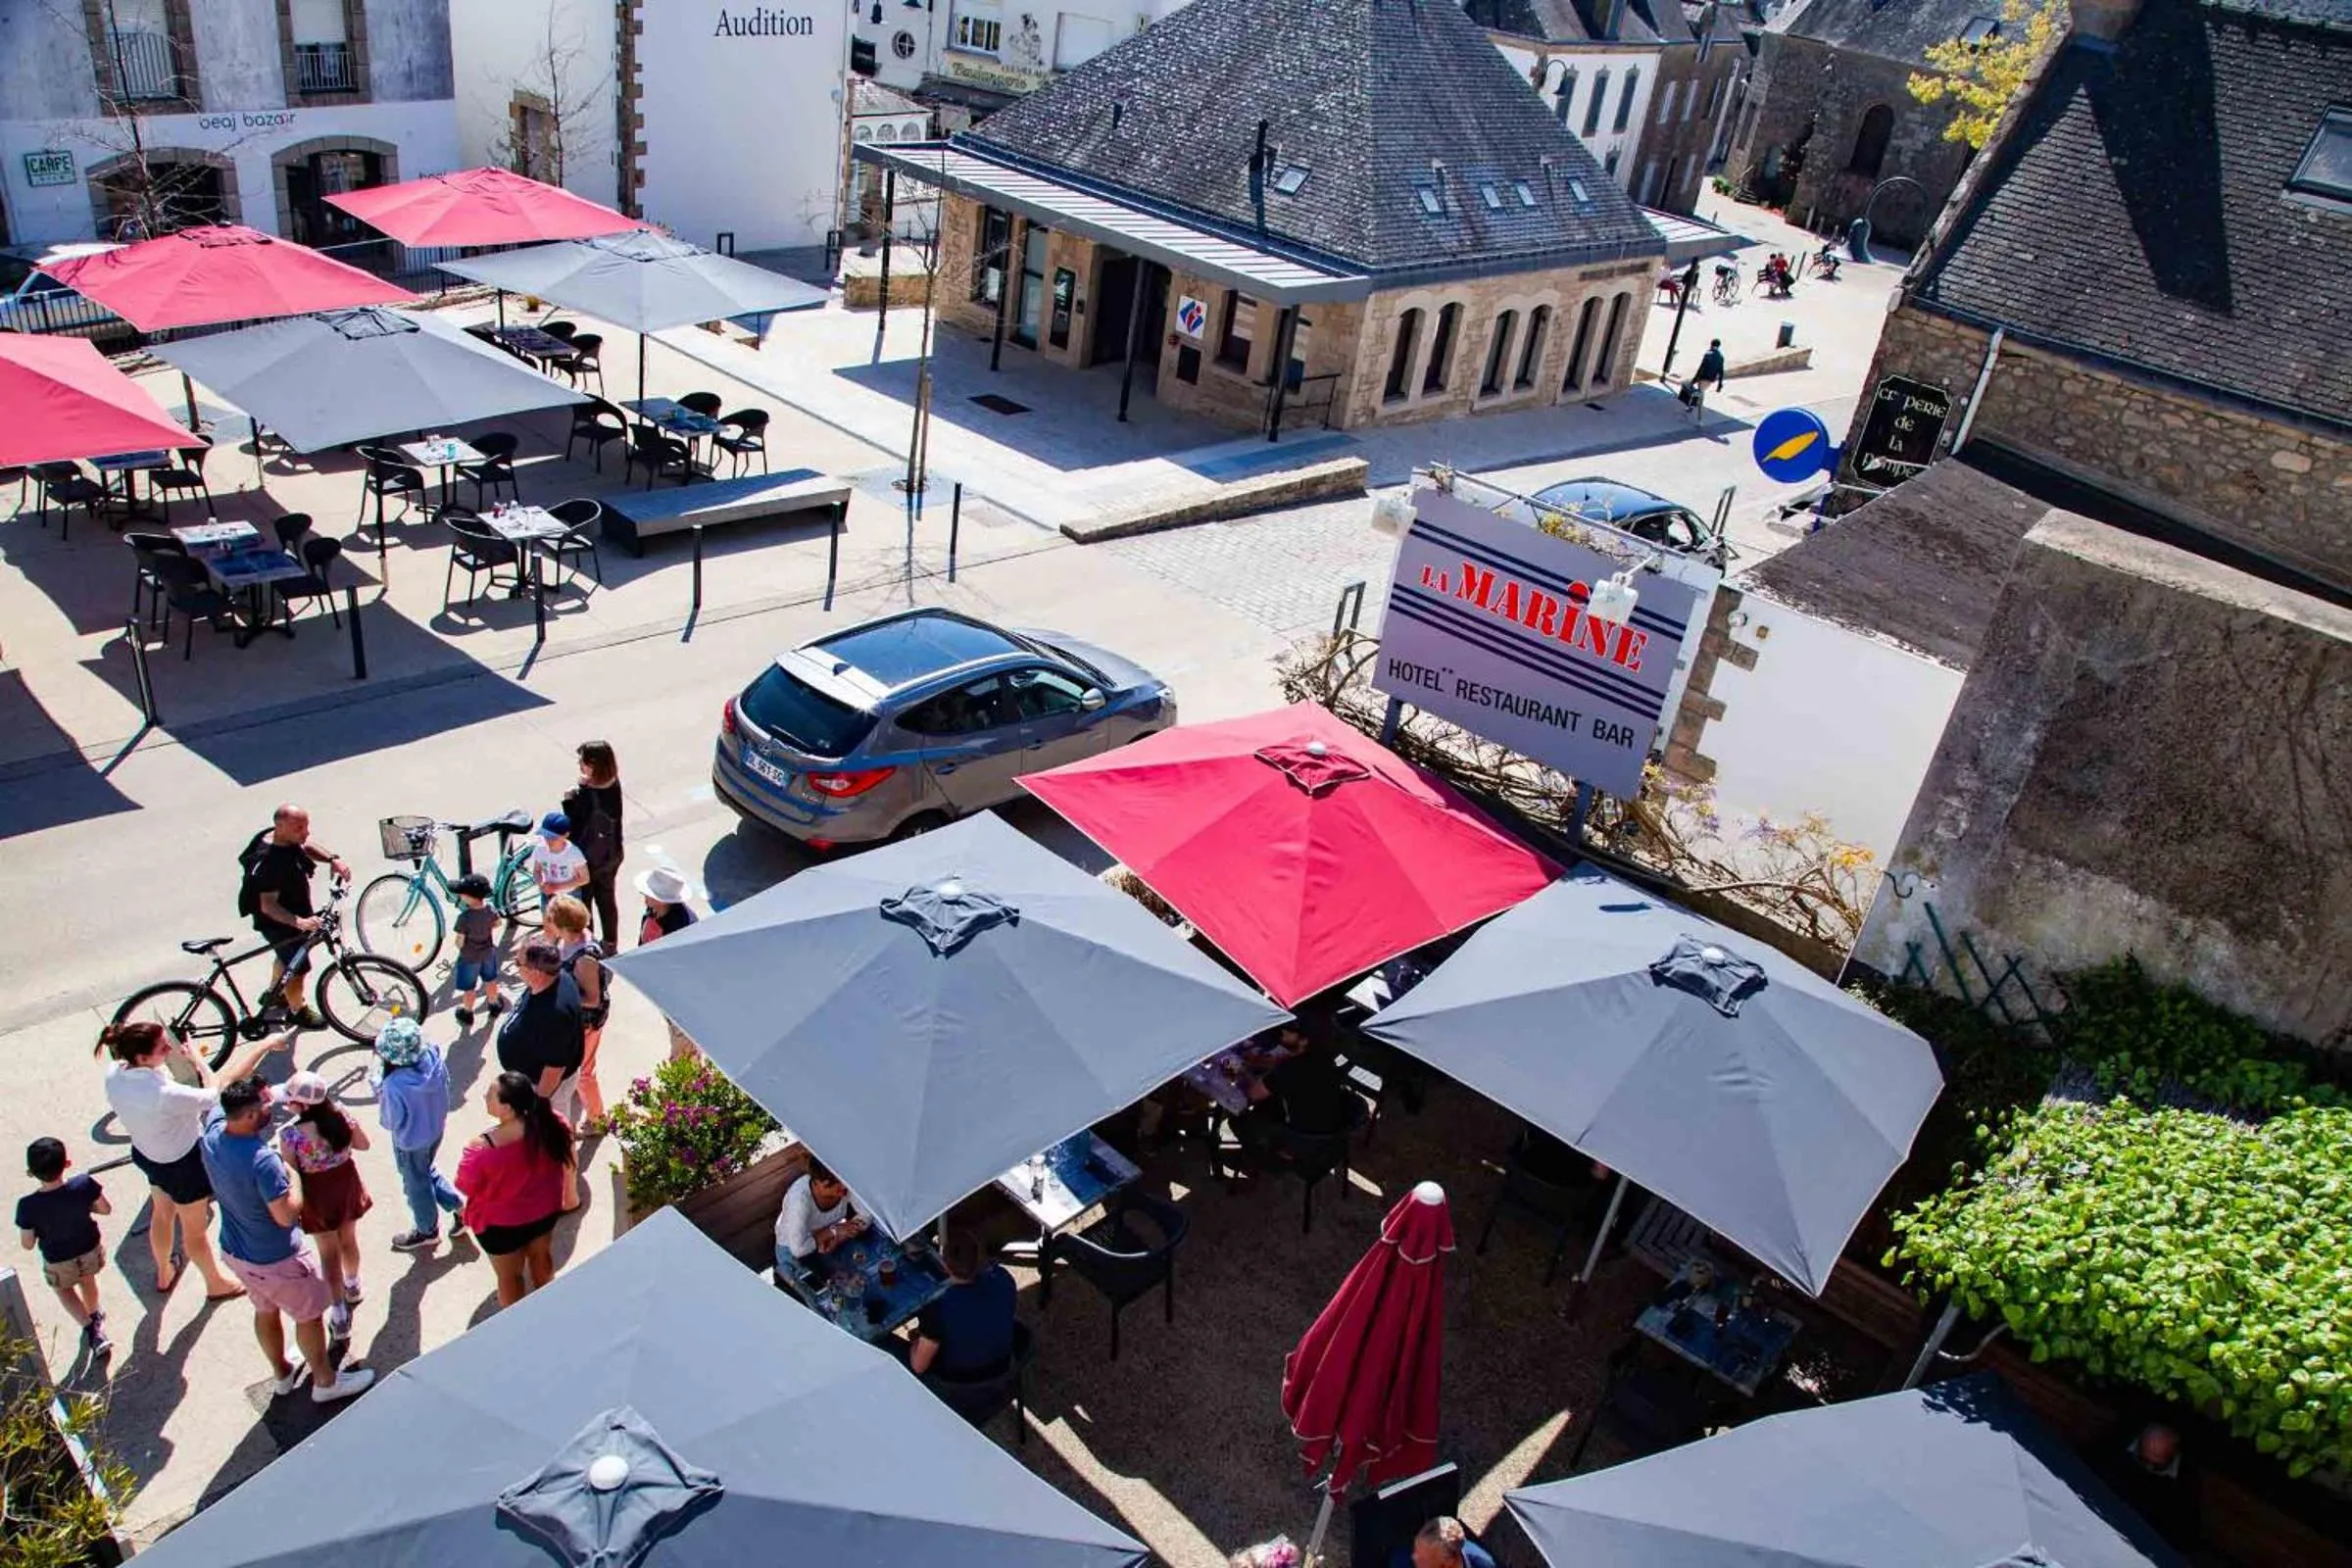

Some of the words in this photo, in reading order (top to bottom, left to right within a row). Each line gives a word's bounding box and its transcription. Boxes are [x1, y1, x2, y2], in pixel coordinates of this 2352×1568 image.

[713, 7, 813, 37] Audition
[1420, 563, 1450, 593] LA
[1455, 676, 1582, 733] RESTAURANT
[1592, 716, 1636, 749] BAR
